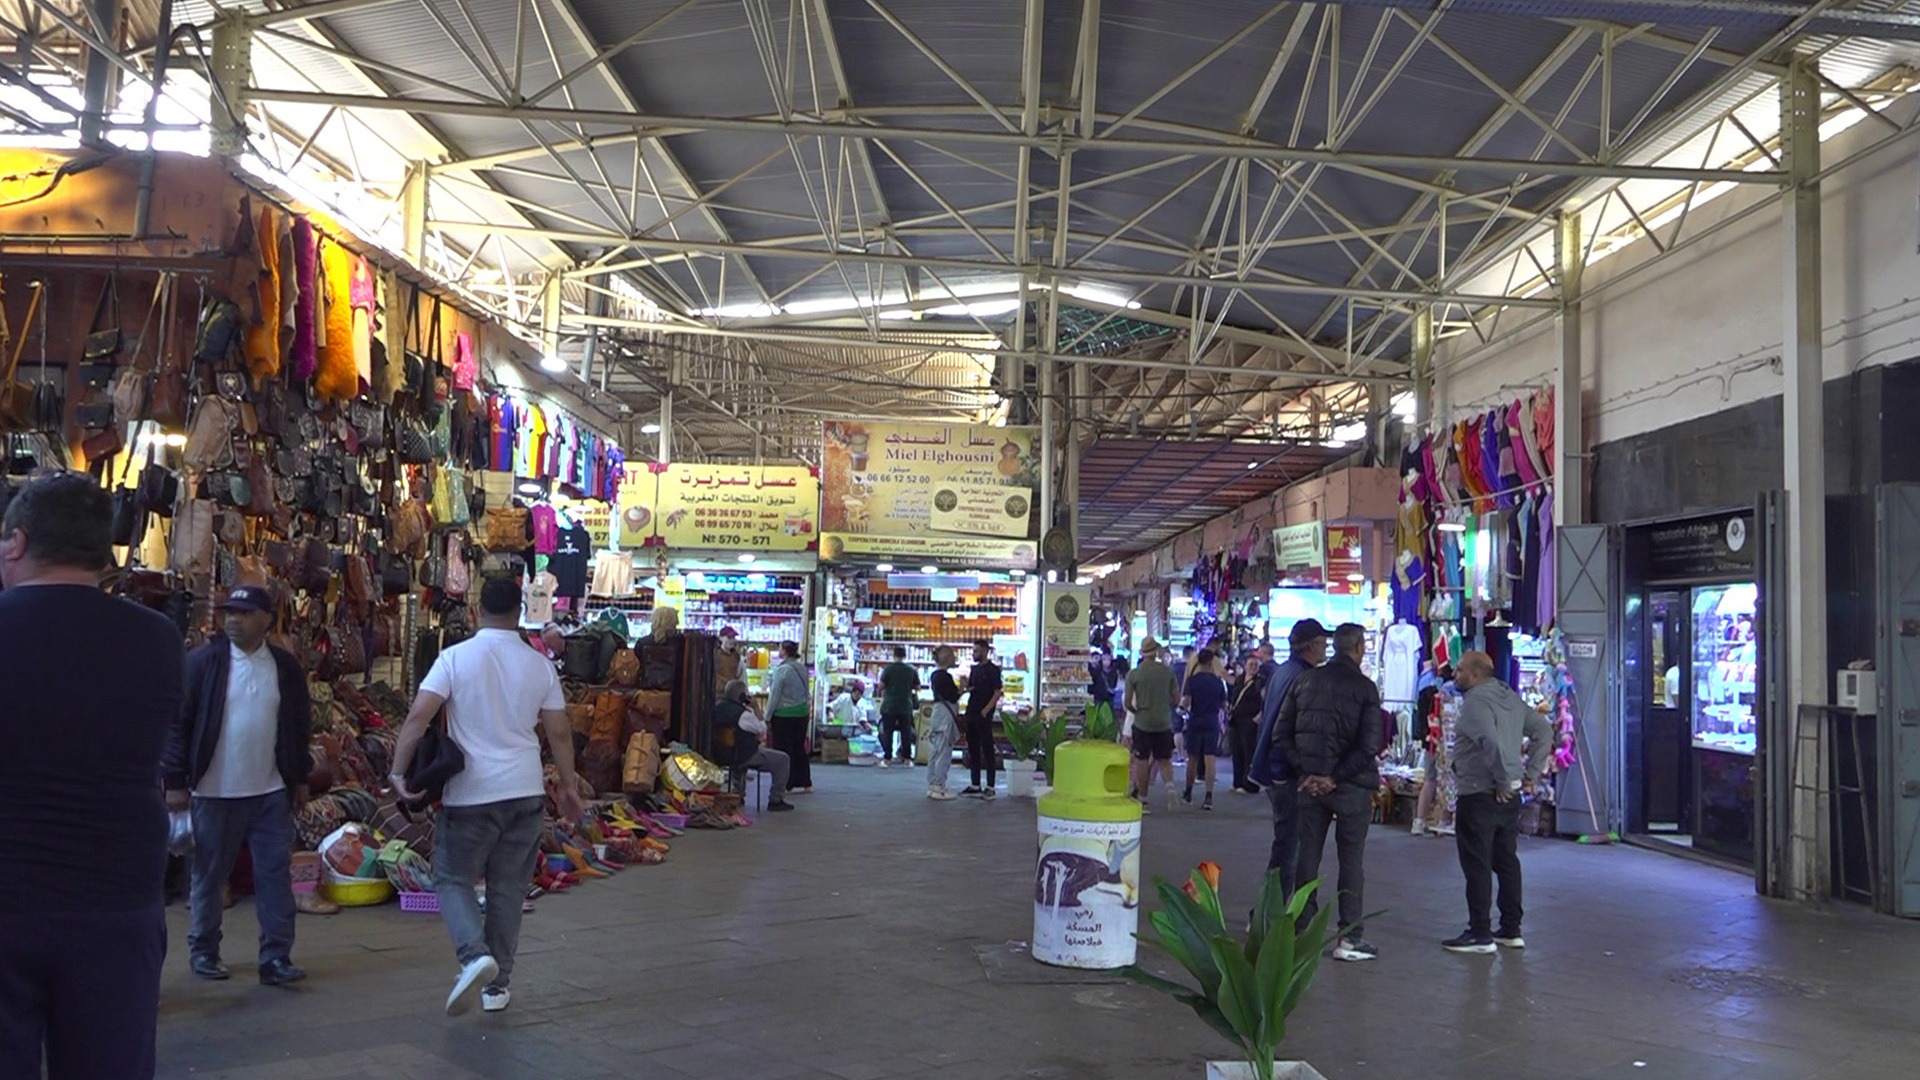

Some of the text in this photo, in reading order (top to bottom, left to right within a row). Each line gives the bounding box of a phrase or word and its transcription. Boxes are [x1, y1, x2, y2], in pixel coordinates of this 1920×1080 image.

[960, 428, 995, 449] عسل
[885, 449, 995, 465] Miel Elghousni
[755, 467, 797, 490] عسل
[867, 473, 930, 484] 06 66 12 52 00
[680, 492, 796, 506] تسويق المنتجات المغربية
[695, 508, 705, 516] 06
[730, 509, 740, 517] 67
[742, 509, 752, 518] 53
[695, 519, 705, 528] 06
[707, 520, 717, 528] 99
[719, 520, 729, 528] 65
[731, 521, 741, 529] 70
[759, 521, 779, 533] بلال
[718, 534, 741, 544] 570
[752, 536, 770, 545] 571
